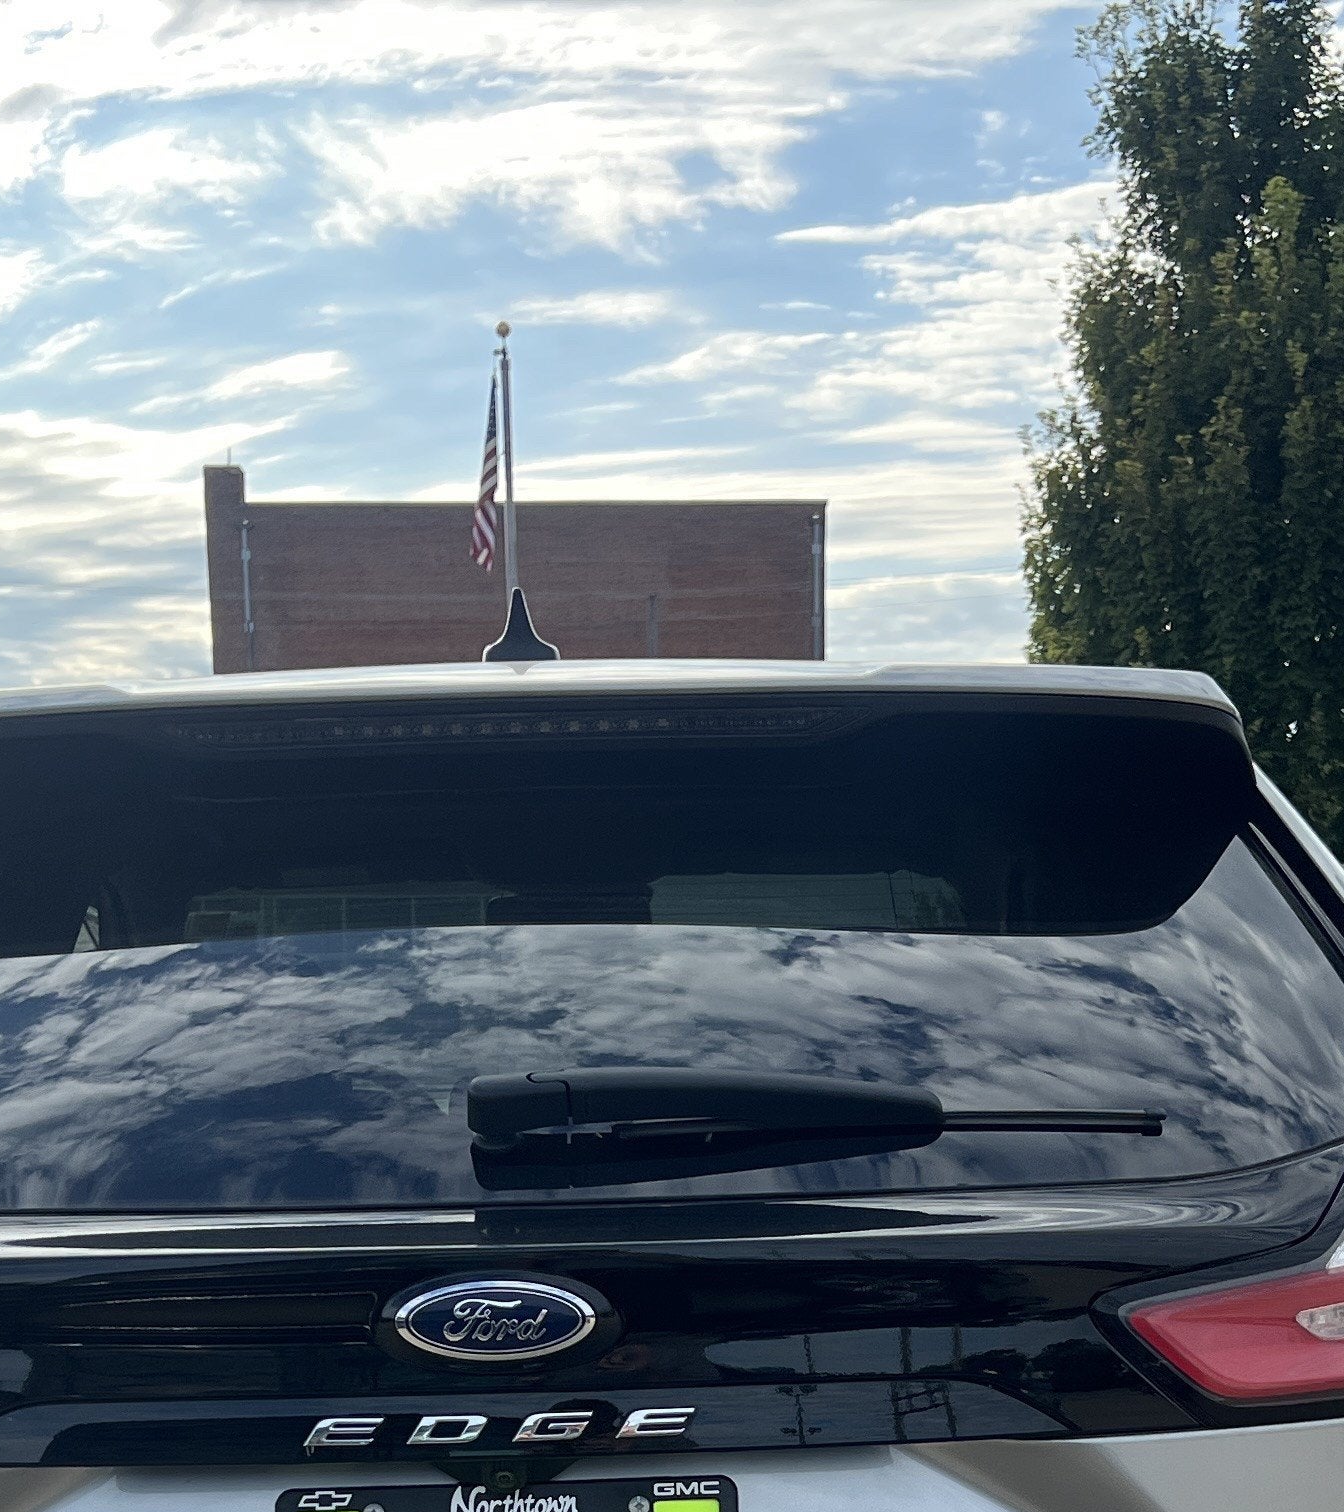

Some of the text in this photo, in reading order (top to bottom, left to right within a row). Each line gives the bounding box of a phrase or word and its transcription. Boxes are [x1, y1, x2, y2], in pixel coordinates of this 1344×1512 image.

[443, 1298, 548, 1342] Ford
[303, 1407, 696, 1448] EDGE
[652, 1480, 721, 1497] GMC
